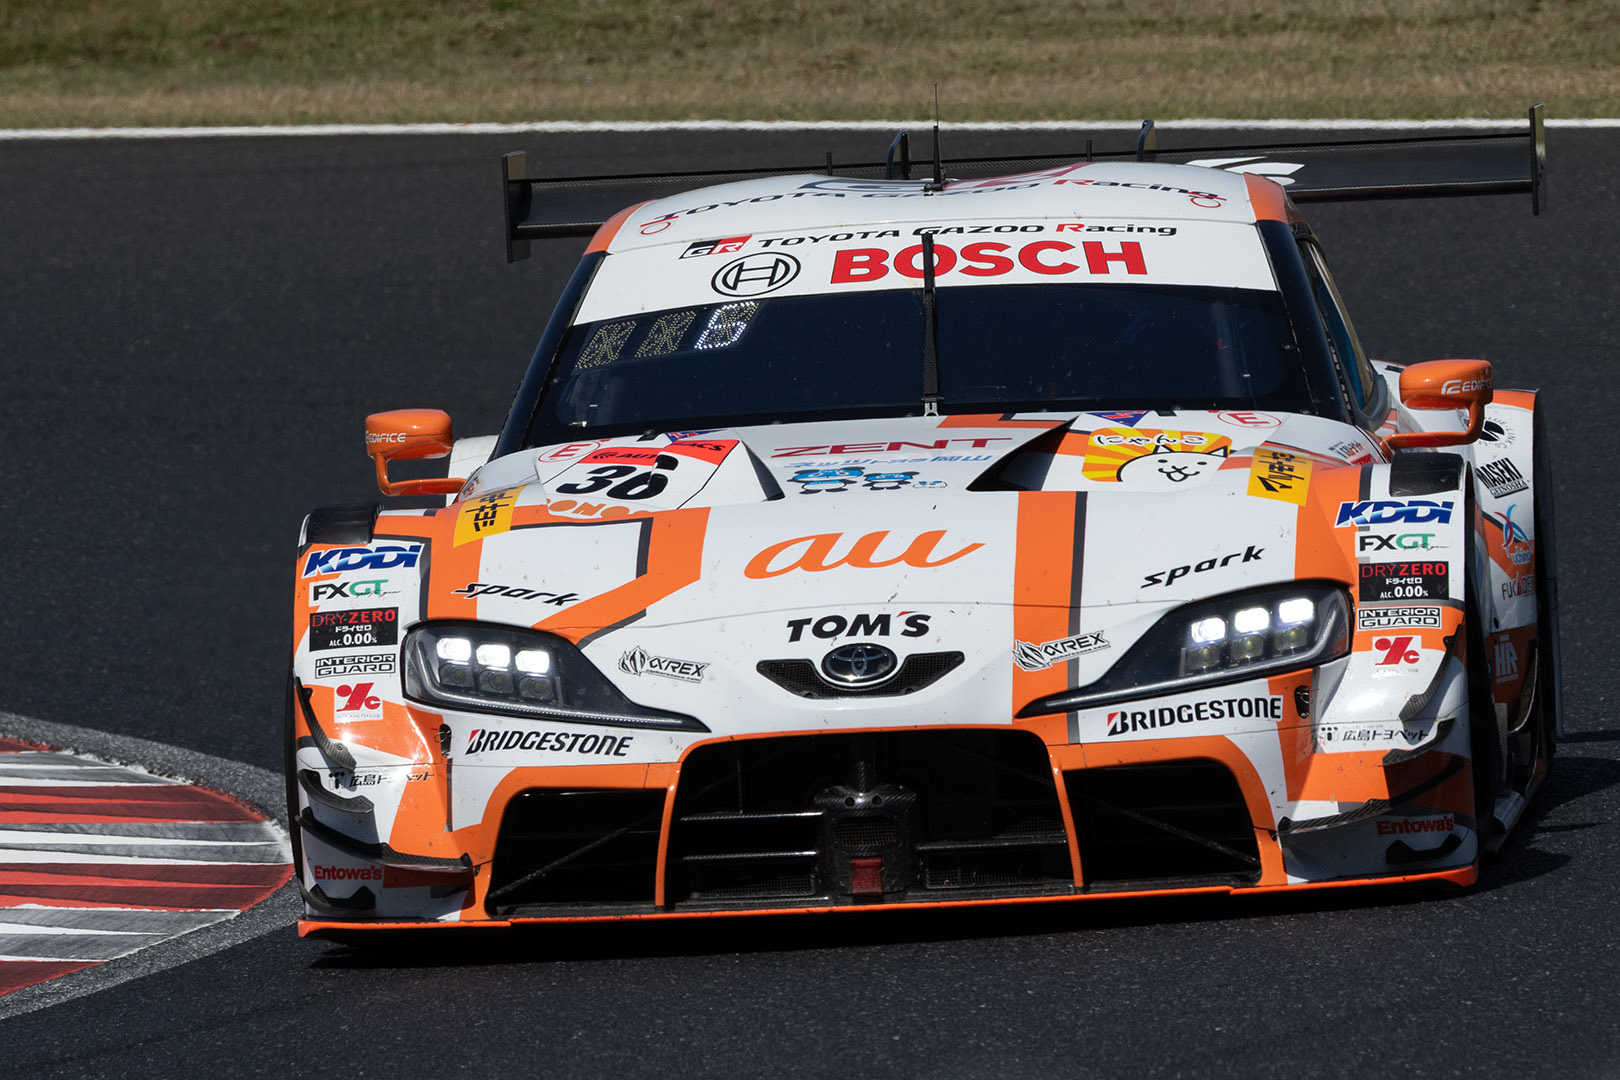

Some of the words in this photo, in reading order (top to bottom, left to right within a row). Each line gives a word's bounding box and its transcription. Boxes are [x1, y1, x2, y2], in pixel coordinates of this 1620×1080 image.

[655, 192, 846, 220] TOYOTA
[1053, 179, 1222, 200] Racing
[758, 229, 900, 248] TOYOTA
[912, 224, 1045, 237] GAZOO
[1055, 223, 1177, 237] Racing
[688, 241, 744, 257] GR
[831, 240, 1148, 284] BOSCH
[549, 443, 592, 458] E
[771, 437, 1013, 459] ZENT
[556, 454, 679, 500] 36
[1475, 457, 1524, 490] MASEKI
[1336, 501, 1454, 526] KDDI
[1359, 533, 1436, 551] FXGT
[304, 545, 422, 576] KDDI
[744, 530, 986, 579] au
[1140, 546, 1266, 588] spark
[1362, 564, 1397, 578] DRY
[1399, 562, 1446, 577] ZERO
[313, 579, 389, 601] FXGT
[1385, 577, 1423, 585] ドライゼロ
[453, 583, 581, 606] spark
[1380, 591, 1394, 599] ALC.
[1395, 586, 1429, 598] 0.00%
[312, 613, 347, 628] DRY
[349, 609, 396, 624] ZERO
[1359, 608, 1440, 618] INTERIOR
[1360, 617, 1440, 628] GUARD
[335, 624, 372, 633] ドライゼロ
[787, 611, 931, 643] TOM'S
[329, 639, 342, 647] ALC.
[343, 633, 377, 646] 0.00%
[316, 655, 395, 667] INTERIOR
[317, 664, 395, 677] GUARD
[1107, 696, 1282, 737] BRIDGESTONE
[465, 728, 634, 756] BRIDGESTONE
[1376, 815, 1455, 836] Entowa's
[314, 865, 384, 880] Entowa's
